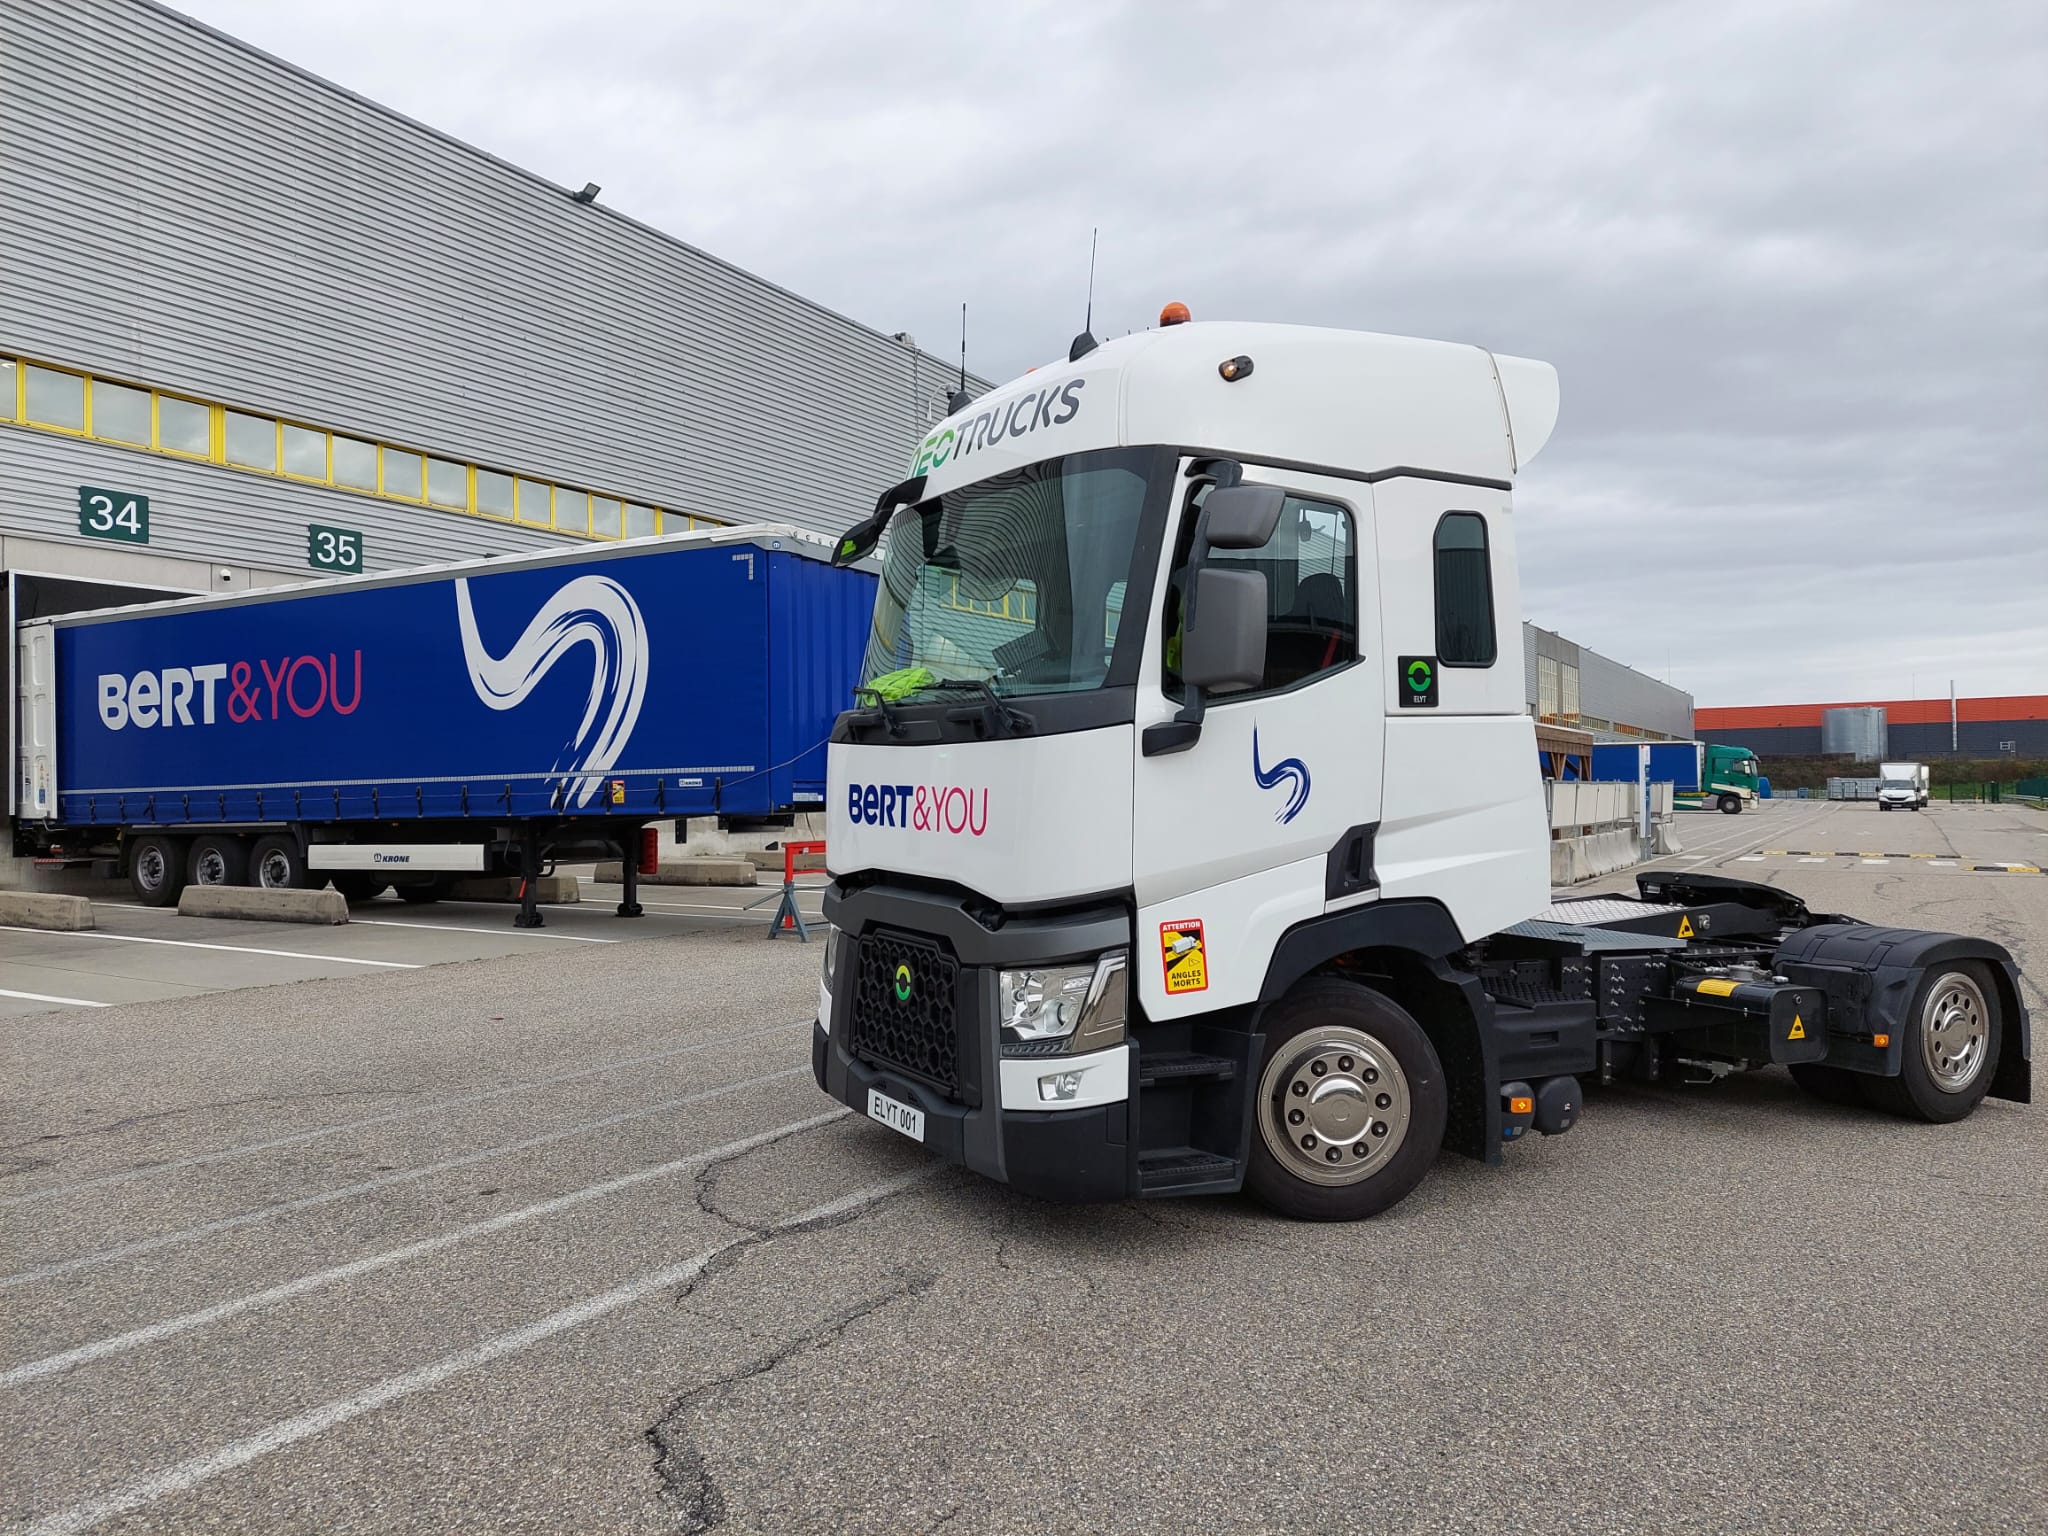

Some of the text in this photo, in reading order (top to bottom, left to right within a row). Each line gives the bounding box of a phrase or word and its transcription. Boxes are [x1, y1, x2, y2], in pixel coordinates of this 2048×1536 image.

[88, 495, 142, 535] 34
[316, 532, 357, 566] 35
[1413, 695, 1427, 703] ELYT
[382, 855, 410, 863] KRONE
[1162, 921, 1201, 931] ATTENTION
[1171, 969, 1202, 980] ANGLES
[1173, 978, 1201, 988] MORTS
[874, 1096, 916, 1134] ELYT 001
